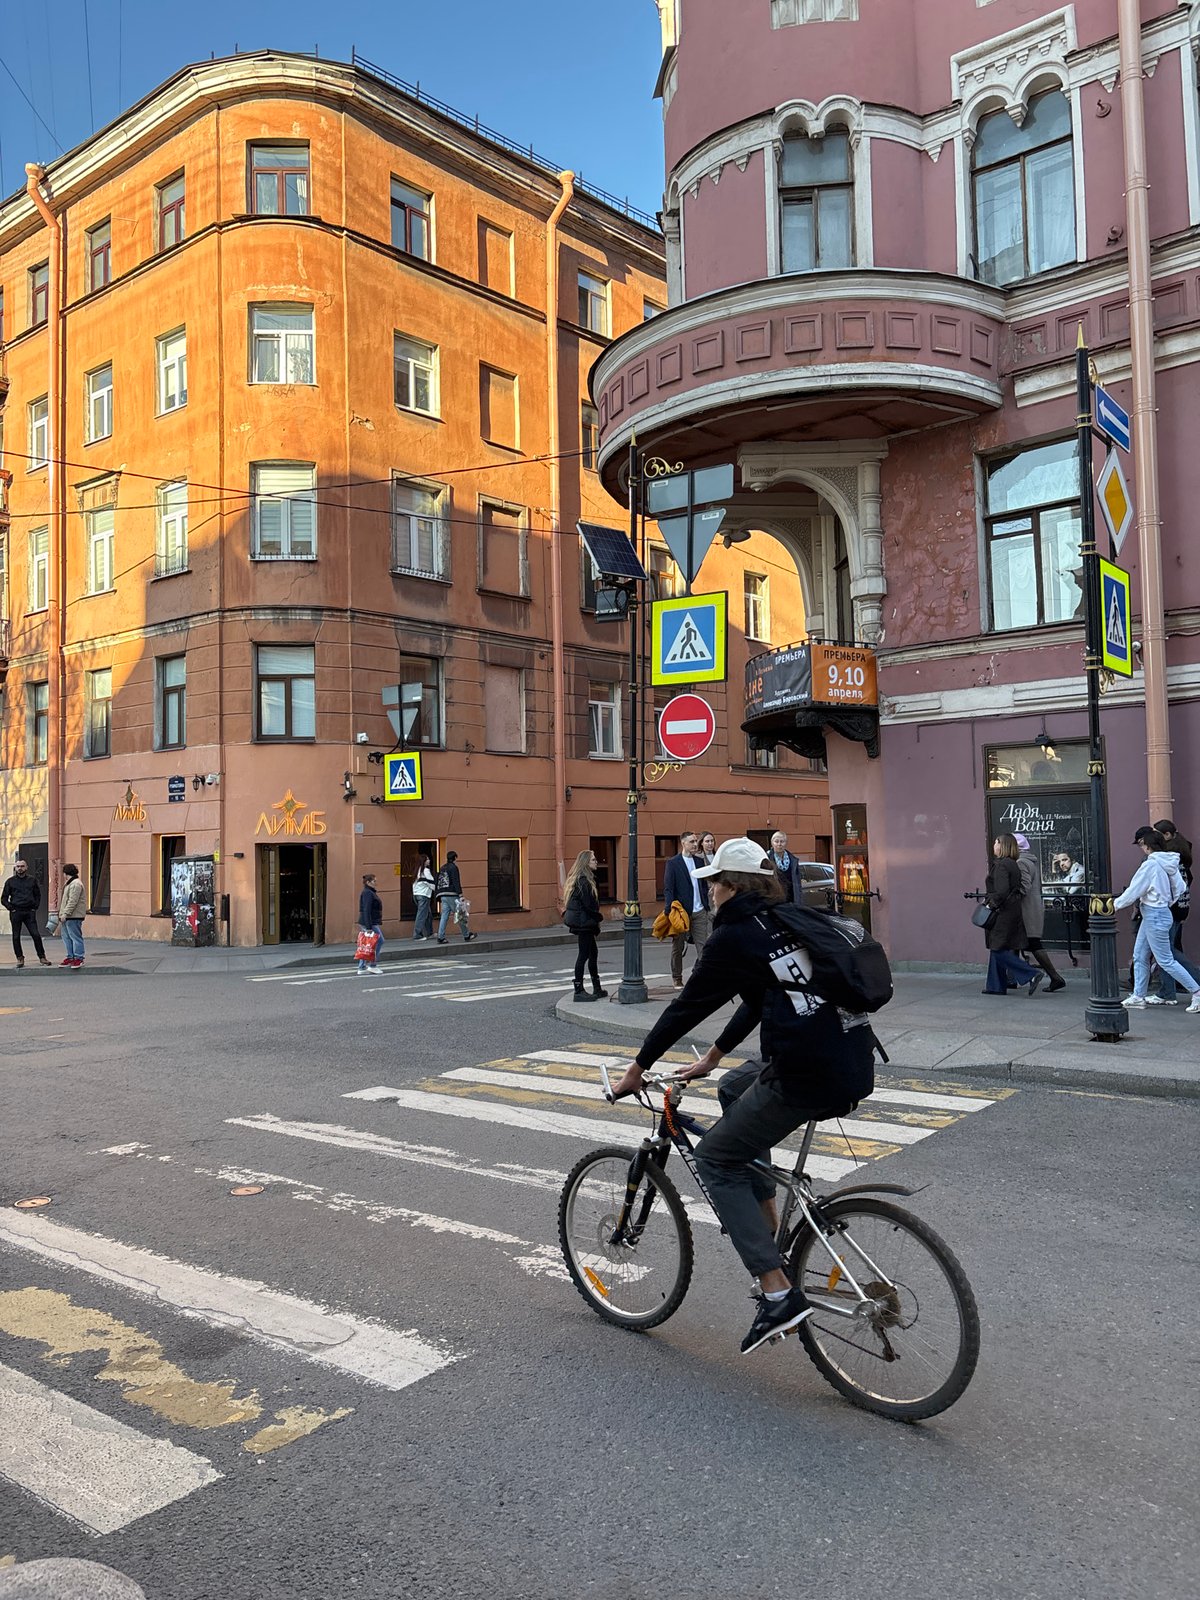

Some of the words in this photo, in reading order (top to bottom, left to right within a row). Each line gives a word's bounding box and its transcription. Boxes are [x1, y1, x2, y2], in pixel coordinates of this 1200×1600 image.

[775, 649, 806, 665] ПРЕМЬЕРА
[823, 649, 866, 662] ПРЕМЬЕРА
[828, 664, 865, 686] 9,10
[828, 687, 863, 699] апреля
[114, 801, 147, 821] ЛИМБ
[1000, 803, 1040, 823] Дядя
[255, 811, 327, 836] ЛИМБ
[1014, 817, 1055, 832] Ваня
